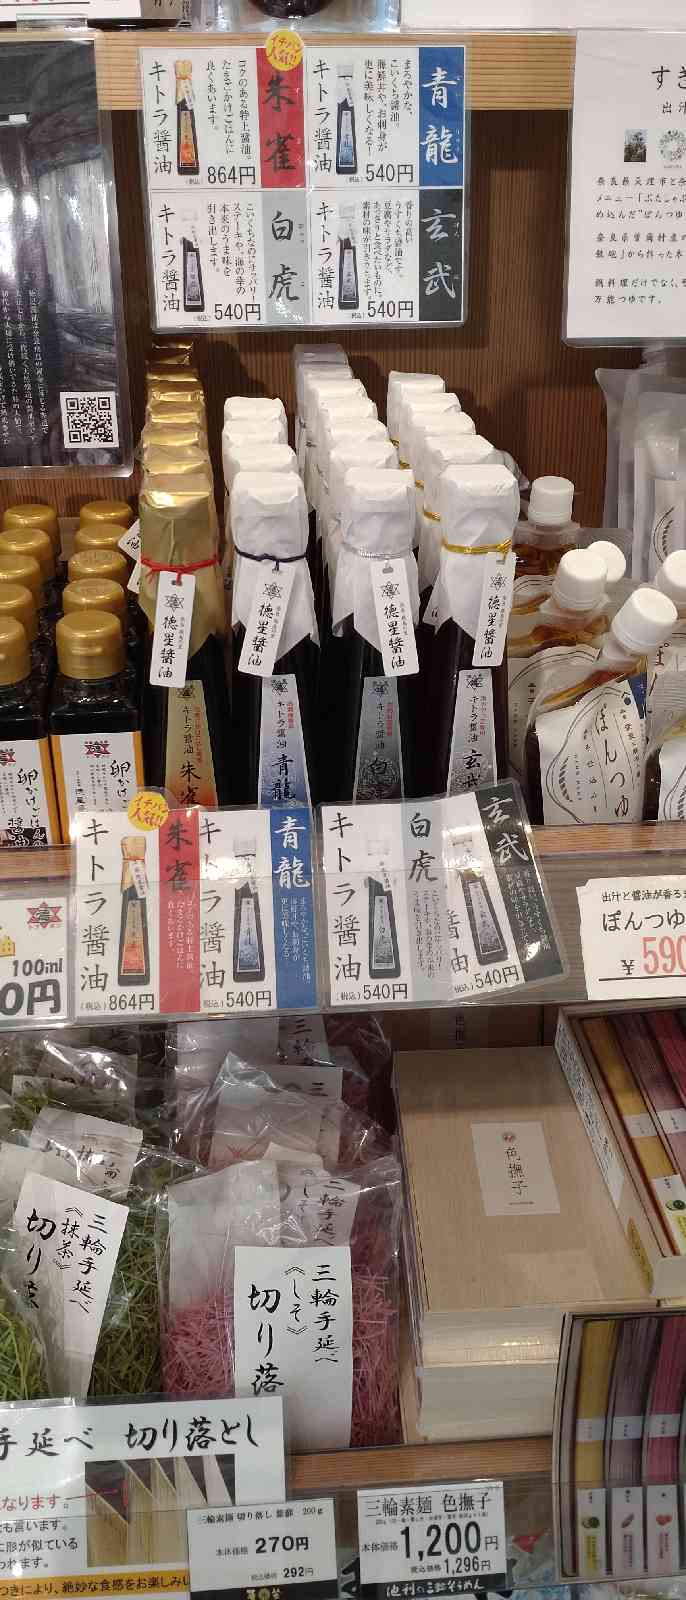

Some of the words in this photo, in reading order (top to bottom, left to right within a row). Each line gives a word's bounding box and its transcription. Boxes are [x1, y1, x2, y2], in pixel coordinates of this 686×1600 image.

[149, 60, 173, 176] キトラ醤油
[262, 74, 298, 173] 朱雀
[313, 60, 333, 174] キトラ醤油
[419, 67, 458, 166] 青龍
[207, 166, 256, 185] 864円
[366, 164, 414, 184] 540円
[158, 204, 180, 312] キトラ醤油
[268, 210, 300, 301] 白虎
[316, 202, 335, 309] キトラ醤油
[420, 208, 457, 299] 玄武
[214, 303, 261, 321] 540円
[367, 300, 414, 318] 540円
[181, 706, 194, 755] キトラ醤油
[276, 701, 287, 749] キトラ醤油
[375, 703, 385, 750] キトラ醤油
[467, 696, 479, 743] キトラ醤油
[272, 754, 296, 801] 青龍
[165, 819, 192, 892] 朱雀
[273, 816, 312, 889] 青龍
[408, 813, 439, 883] 白虎
[481, 796, 530, 867] 玄武
[80, 819, 110, 991] キトラ醤油
[199, 818, 226, 989] キトラ醤油
[329, 813, 362, 981] キトラ醤油
[602, 908, 686, 932] ぽんつゆ
[12, 958, 63, 977] 100ml
[363, 983, 408, 1000] 540円
[474, 964, 520, 990] 540円
[109, 994, 154, 1011] 864円
[226, 990, 272, 1008] 540円
[505, 1146, 529, 1197] 色撫子
[70, 1214, 107, 1314] 三輪手延べ
[309, 1265, 341, 1363] 三輪手延べ
[248, 1284, 285, 1396] 切り落
[125, 1414, 259, 1452] 切り落とし
[365, 1495, 432, 1517] 三輪素麺
[442, 1491, 491, 1513] 色撫子
[255, 1536, 310, 1554] 270円
[444, 1556, 491, 1576] 1,296円
[283, 1567, 314, 1579] 292円
